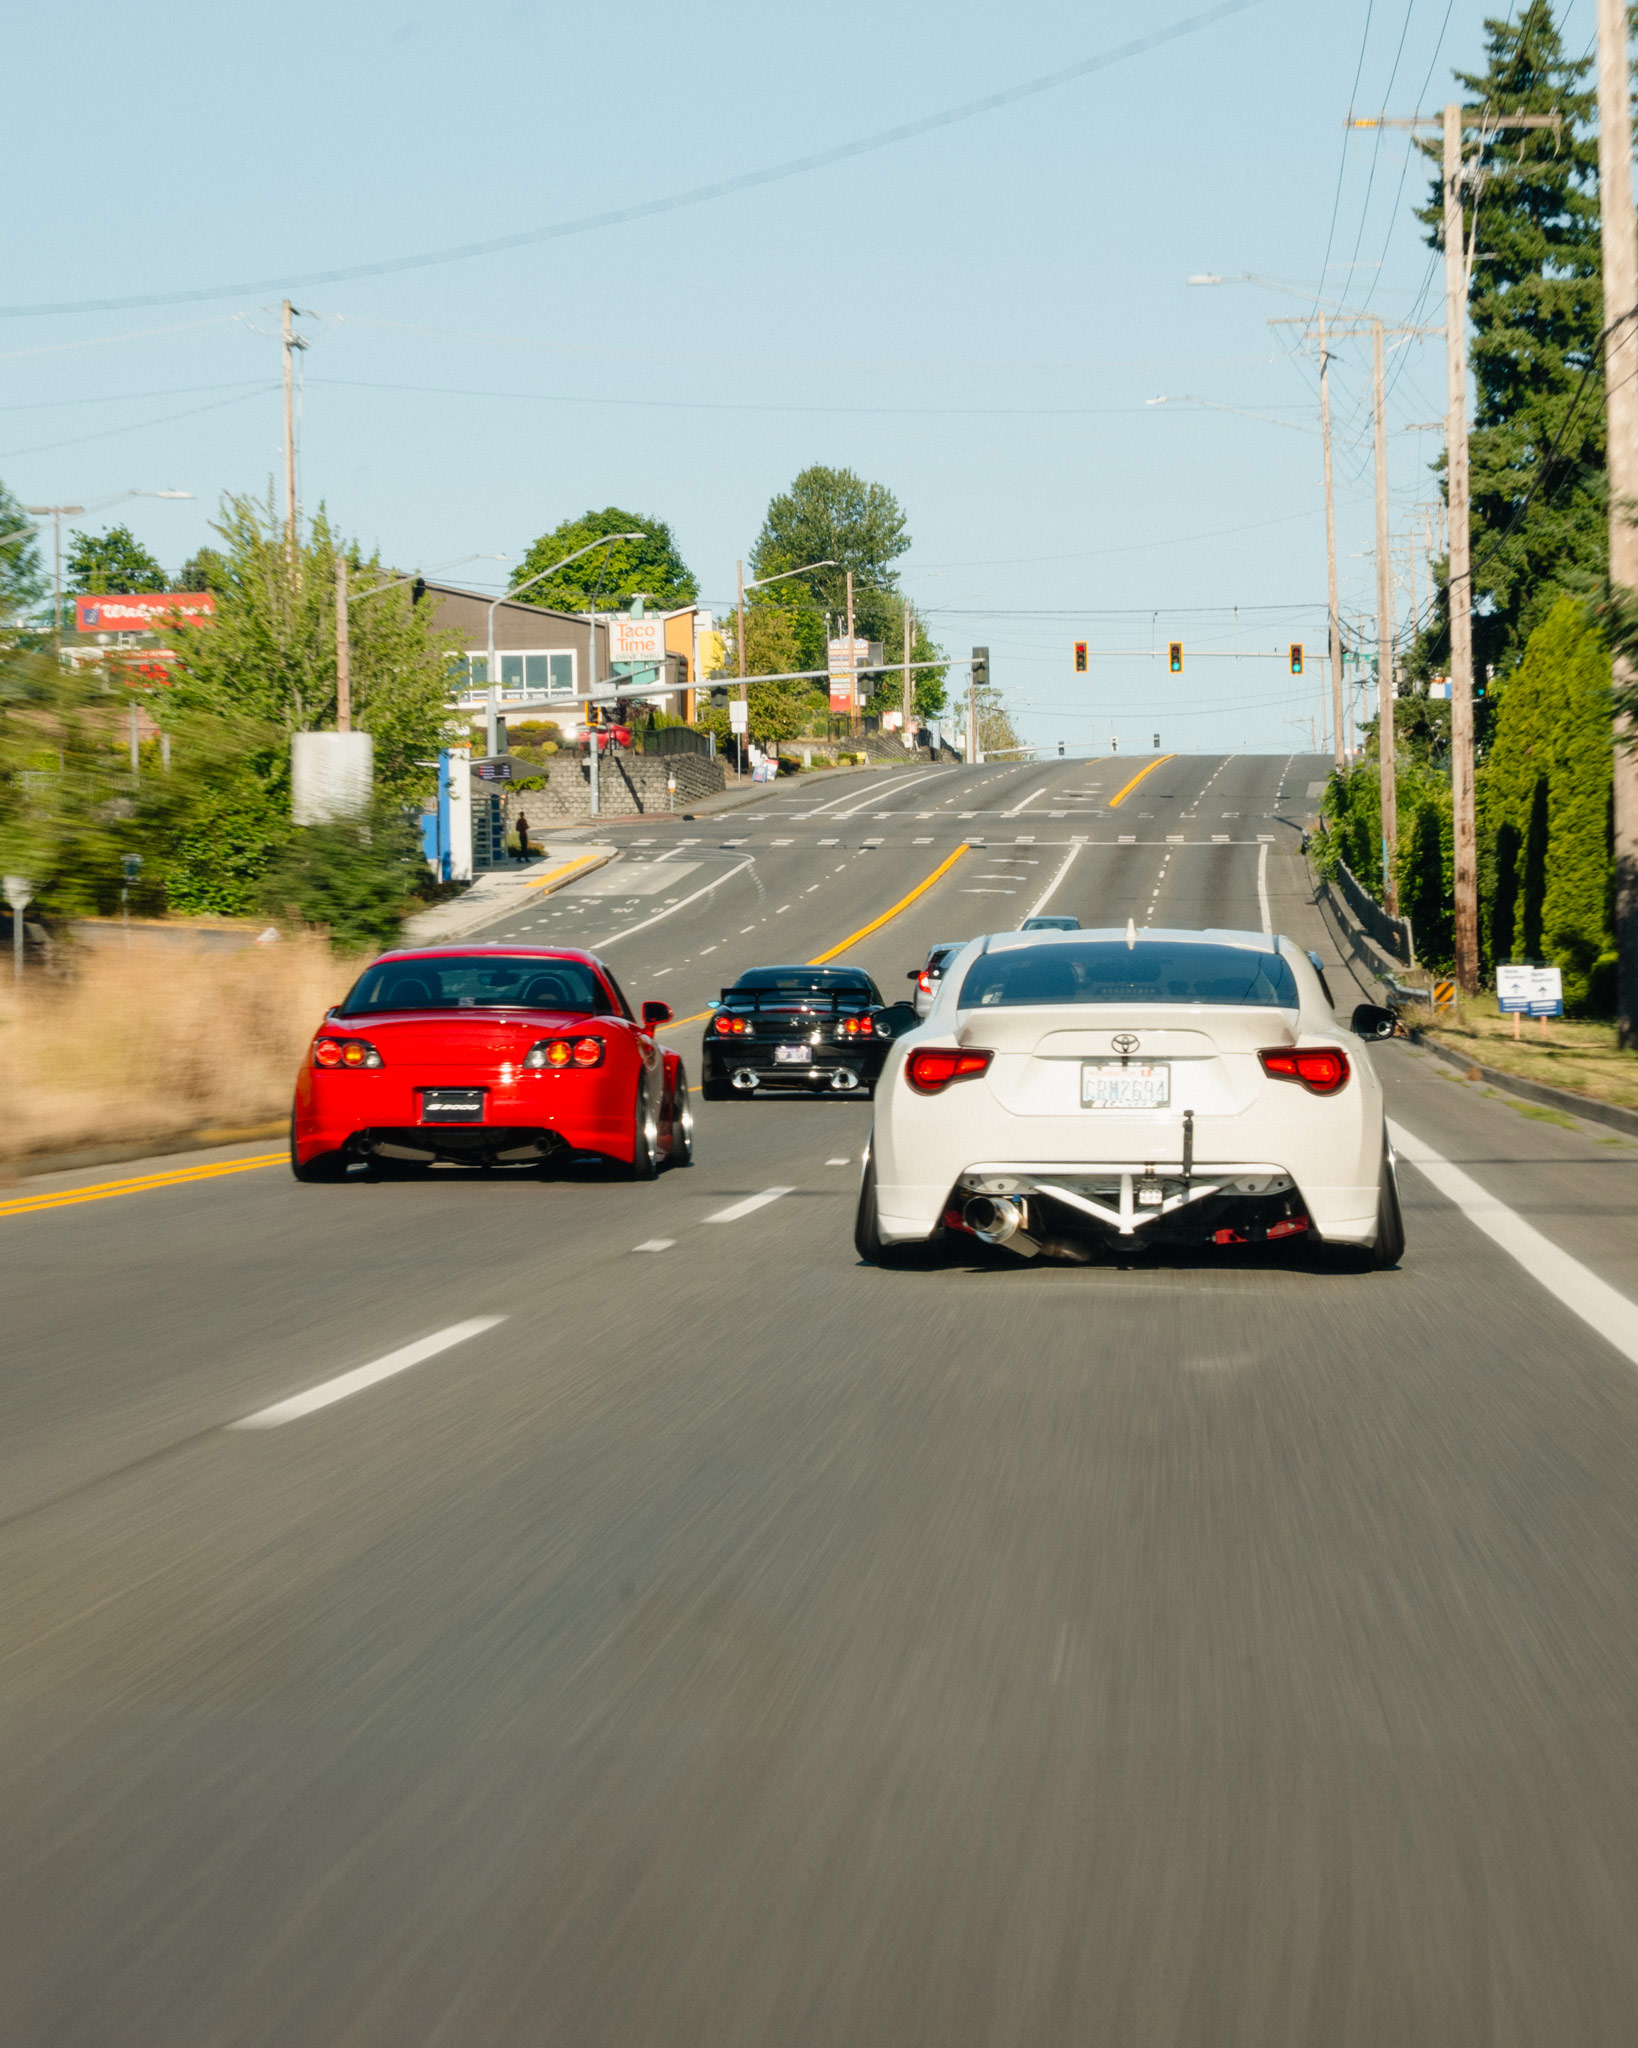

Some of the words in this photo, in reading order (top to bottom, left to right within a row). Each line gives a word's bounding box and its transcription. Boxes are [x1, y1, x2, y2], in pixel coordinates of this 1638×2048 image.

[616, 623, 656, 638] Taco
[616, 638, 656, 651] Time
[425, 1103, 481, 1111] S2000
